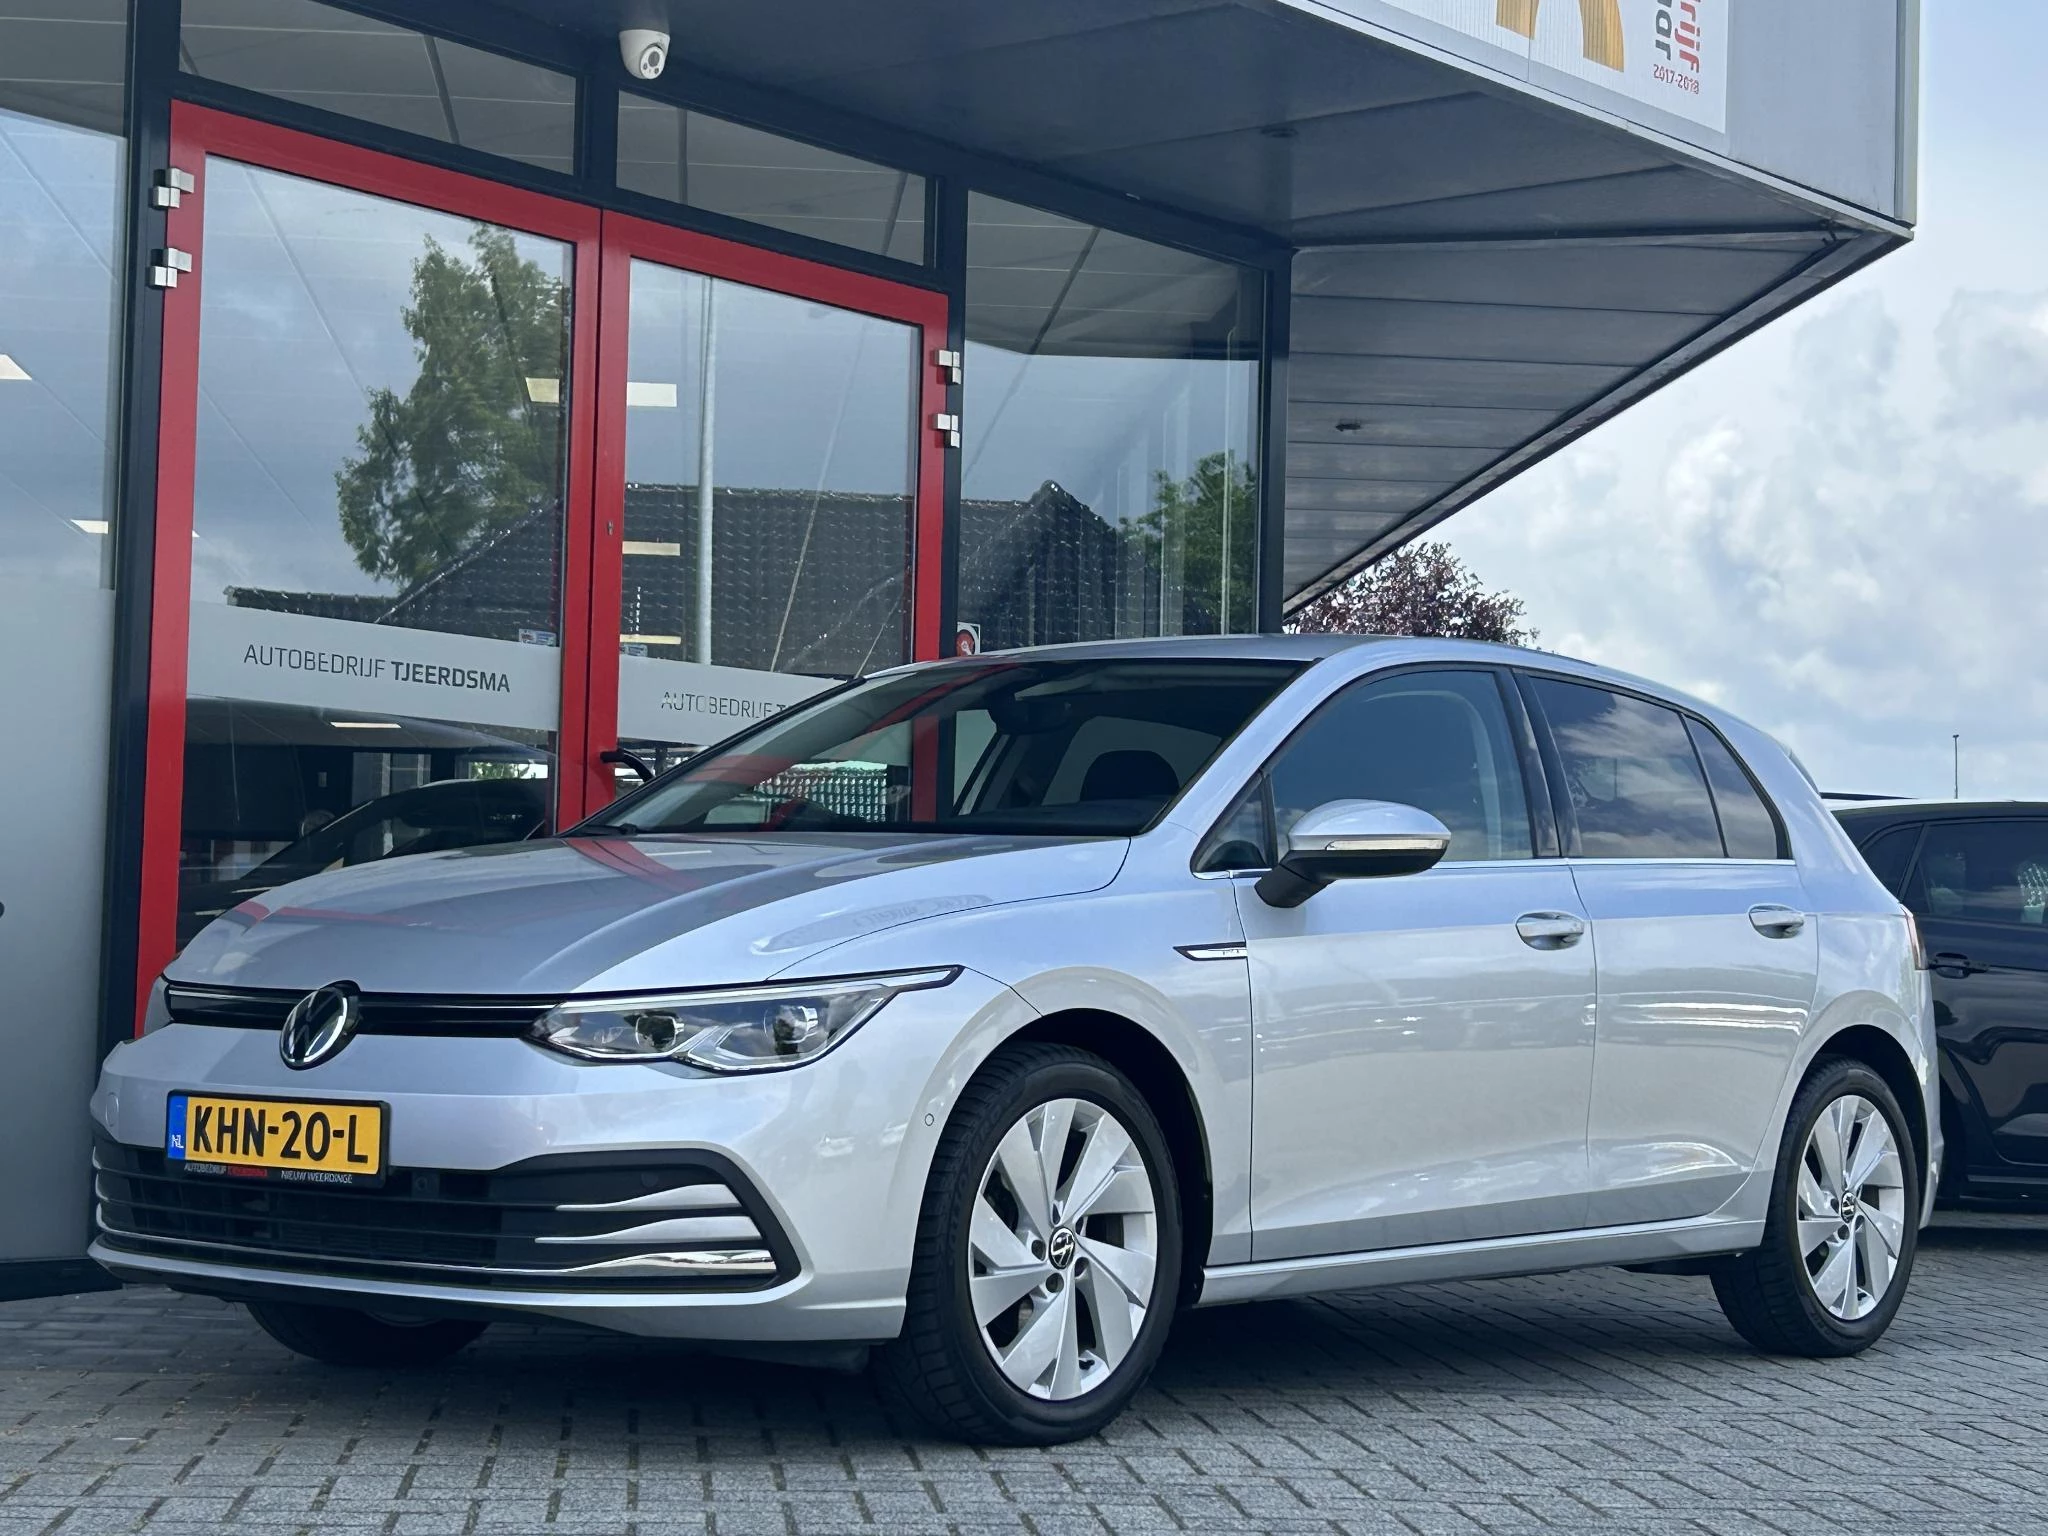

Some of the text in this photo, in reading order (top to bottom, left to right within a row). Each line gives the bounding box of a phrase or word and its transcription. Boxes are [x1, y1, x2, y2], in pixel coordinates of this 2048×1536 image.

[1674, 0, 1700, 73] rijf
[1653, 63, 1700, 95] 2017-2018
[243, 643, 511, 693] AUTOBEDRIJF TJEERDSMA
[192, 1105, 369, 1164] KHN-20-L
